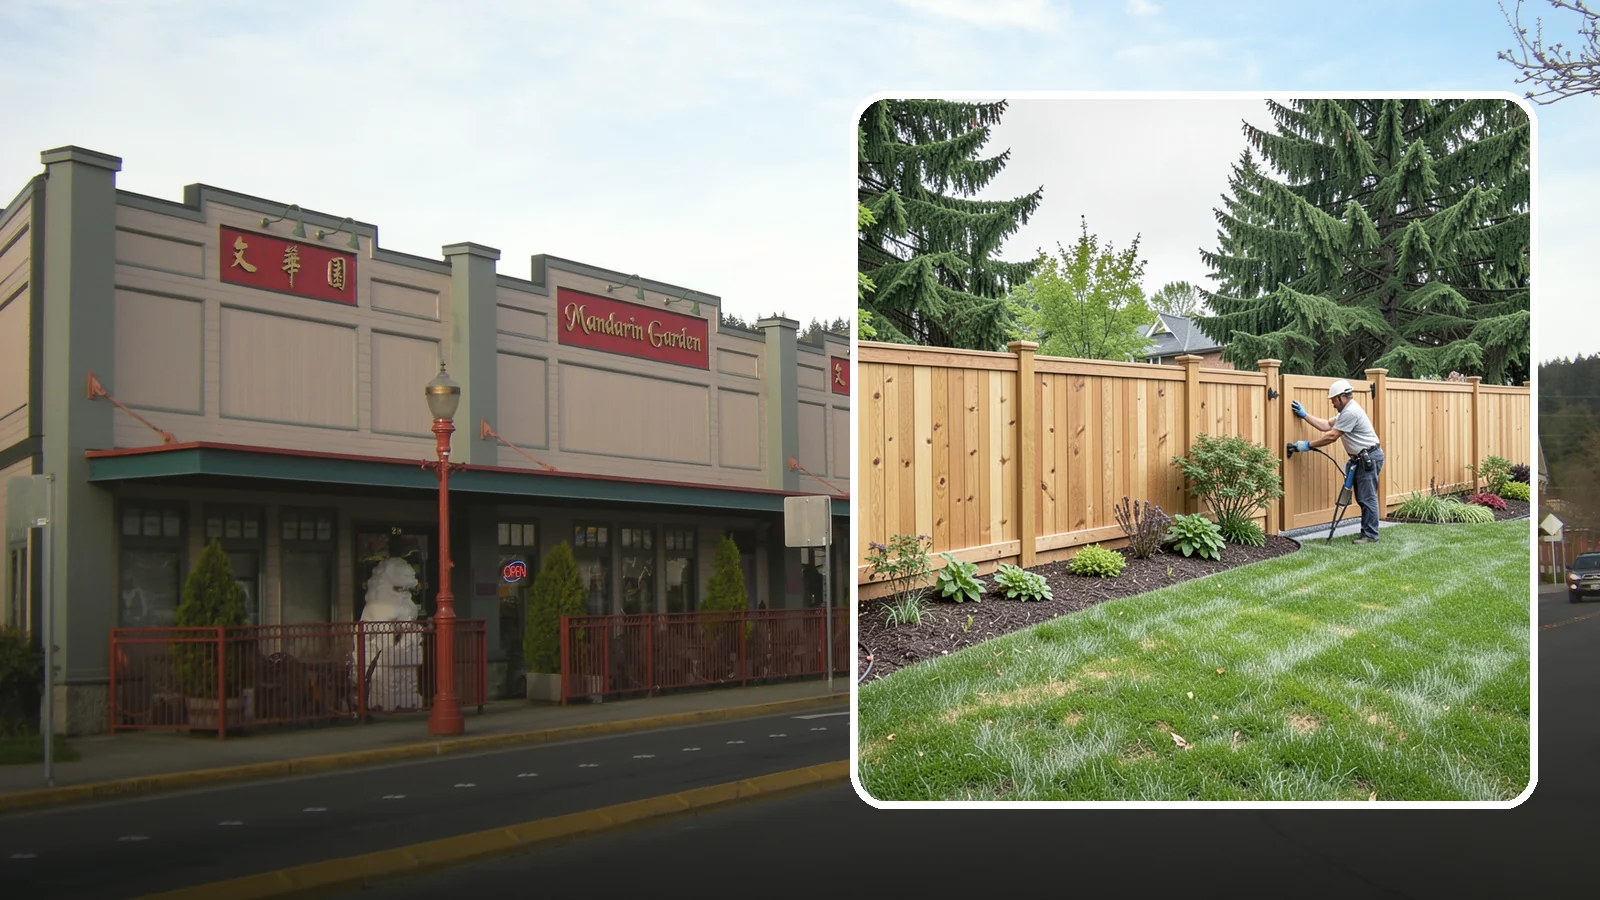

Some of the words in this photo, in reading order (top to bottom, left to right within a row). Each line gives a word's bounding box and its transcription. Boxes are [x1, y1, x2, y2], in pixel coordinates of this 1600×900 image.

[231, 235, 346, 291] 文華園
[564, 302, 644, 341] Mandarin
[648, 320, 701, 352] Garden
[503, 565, 527, 578] OPEN
